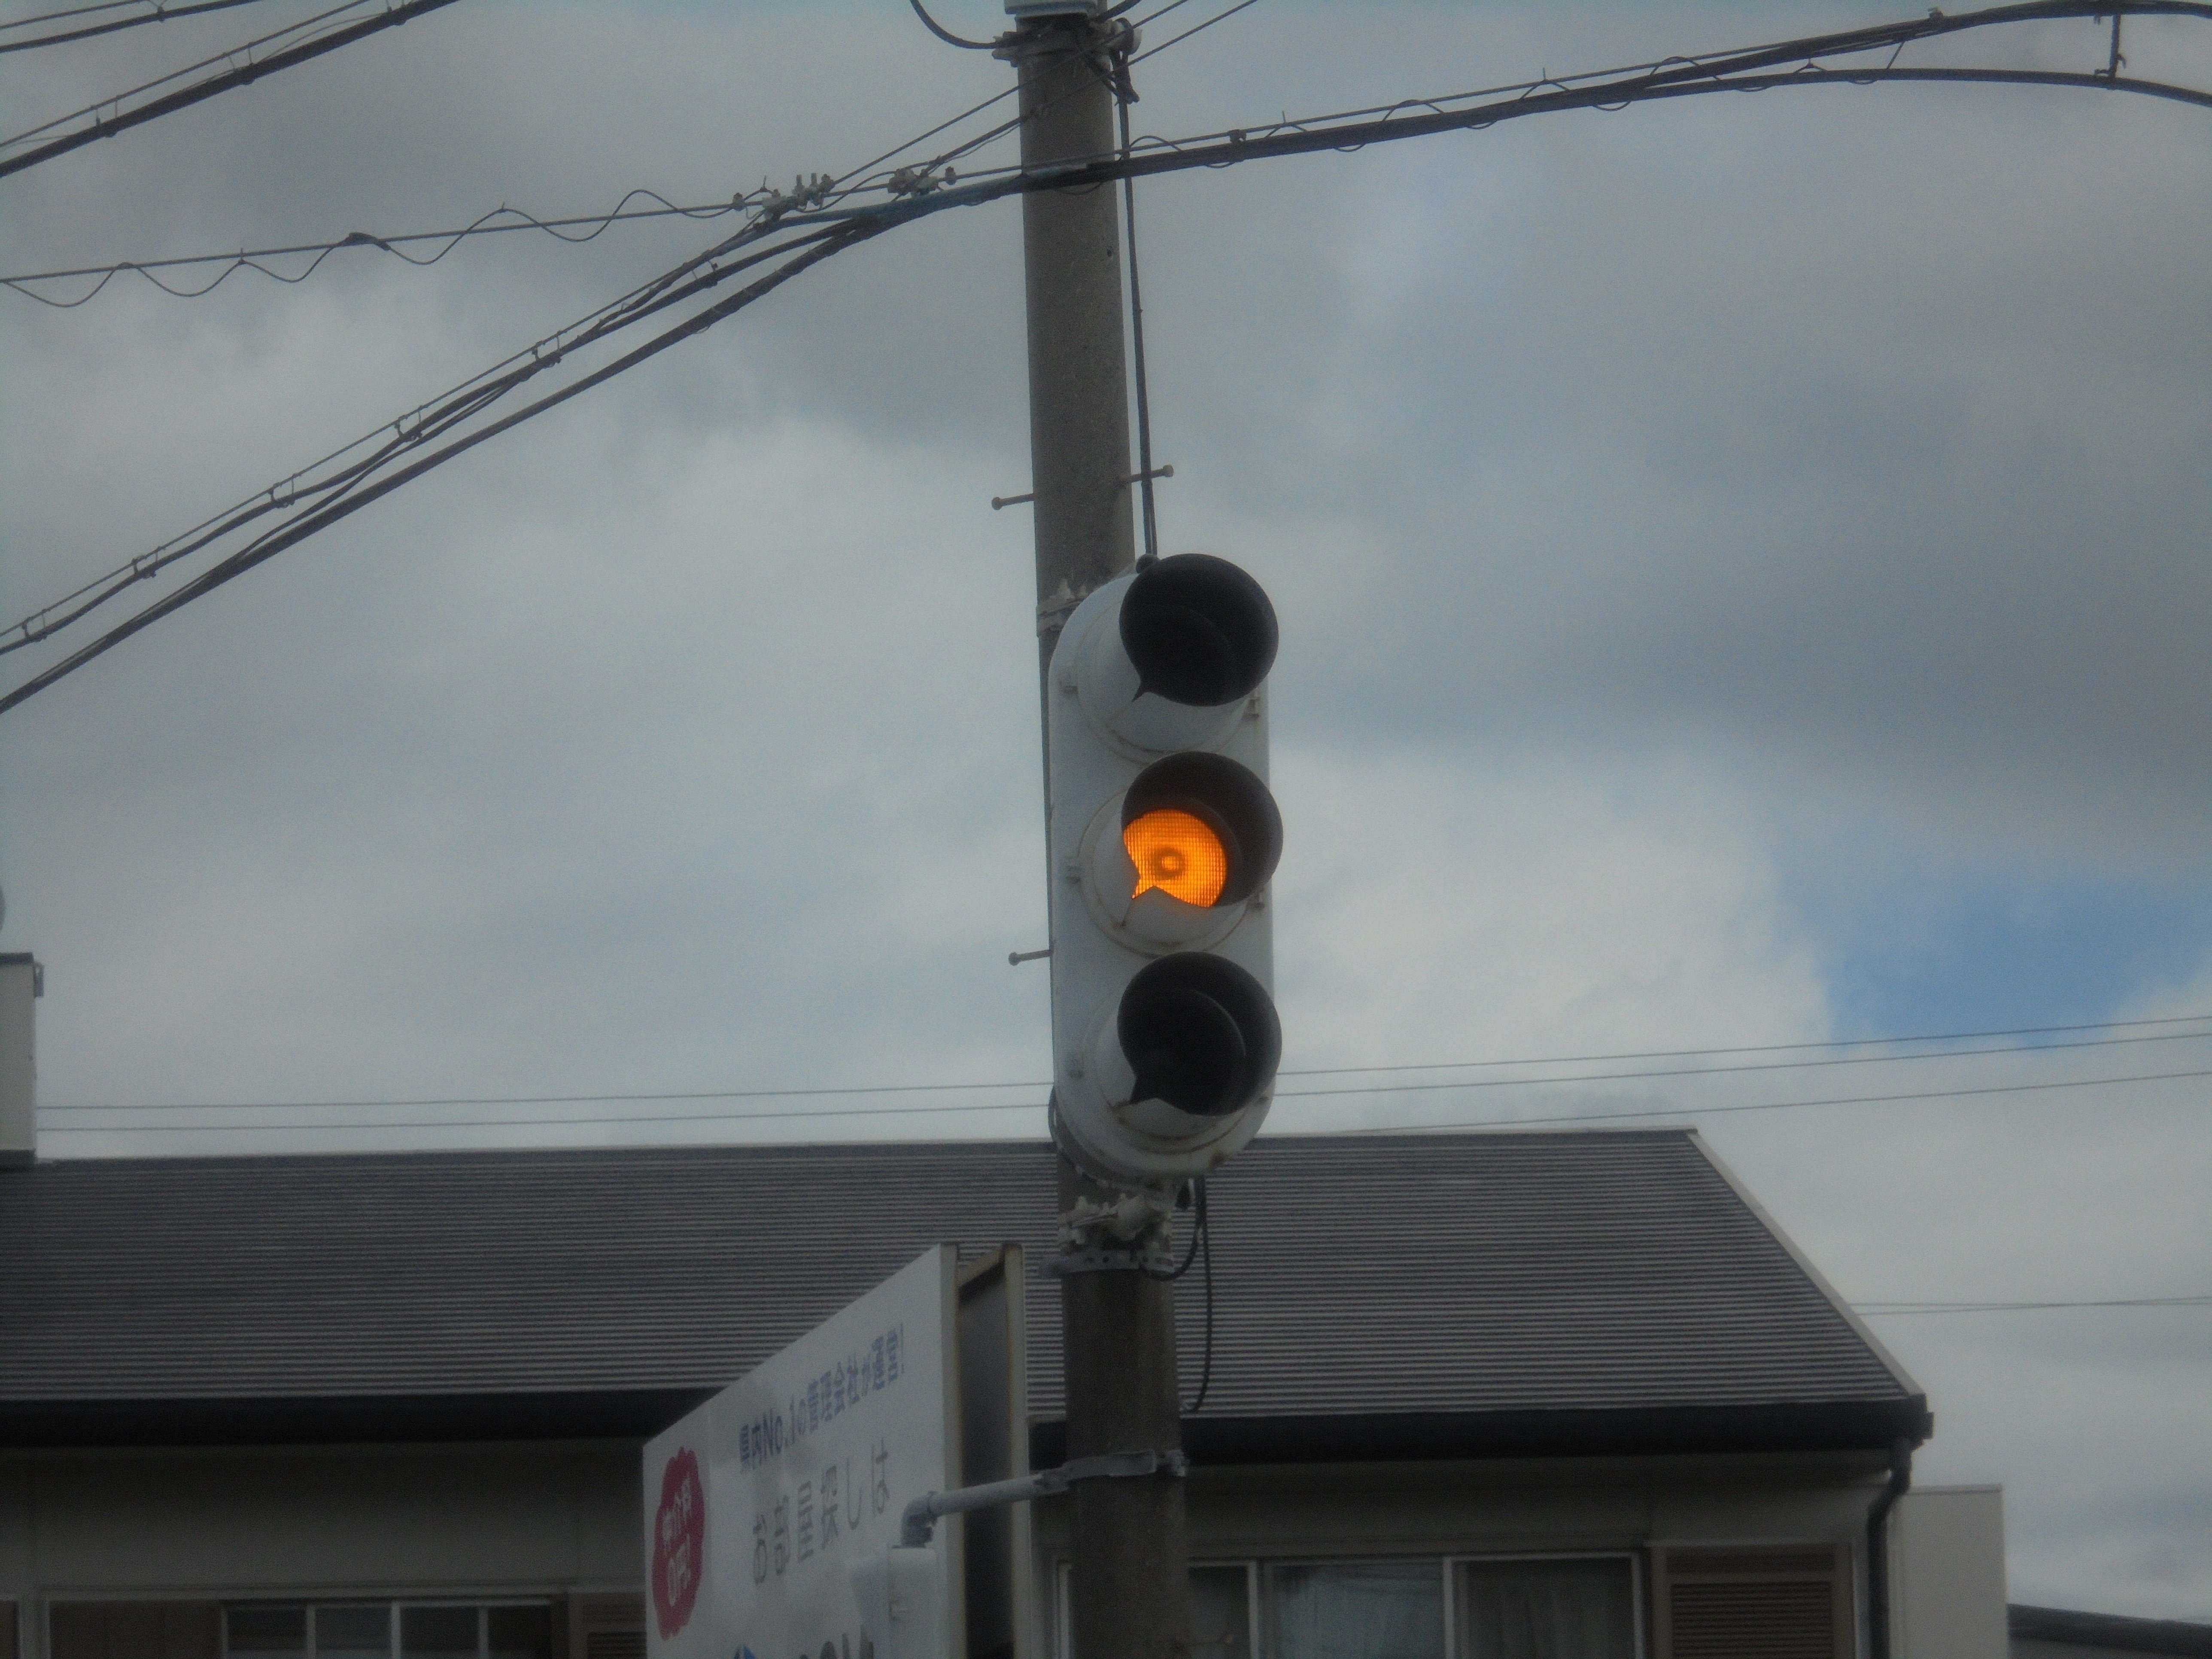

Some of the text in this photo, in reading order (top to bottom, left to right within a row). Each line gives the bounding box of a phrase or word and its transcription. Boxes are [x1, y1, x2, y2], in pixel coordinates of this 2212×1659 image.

[752, 1437, 890, 1584] お部屋探しは
